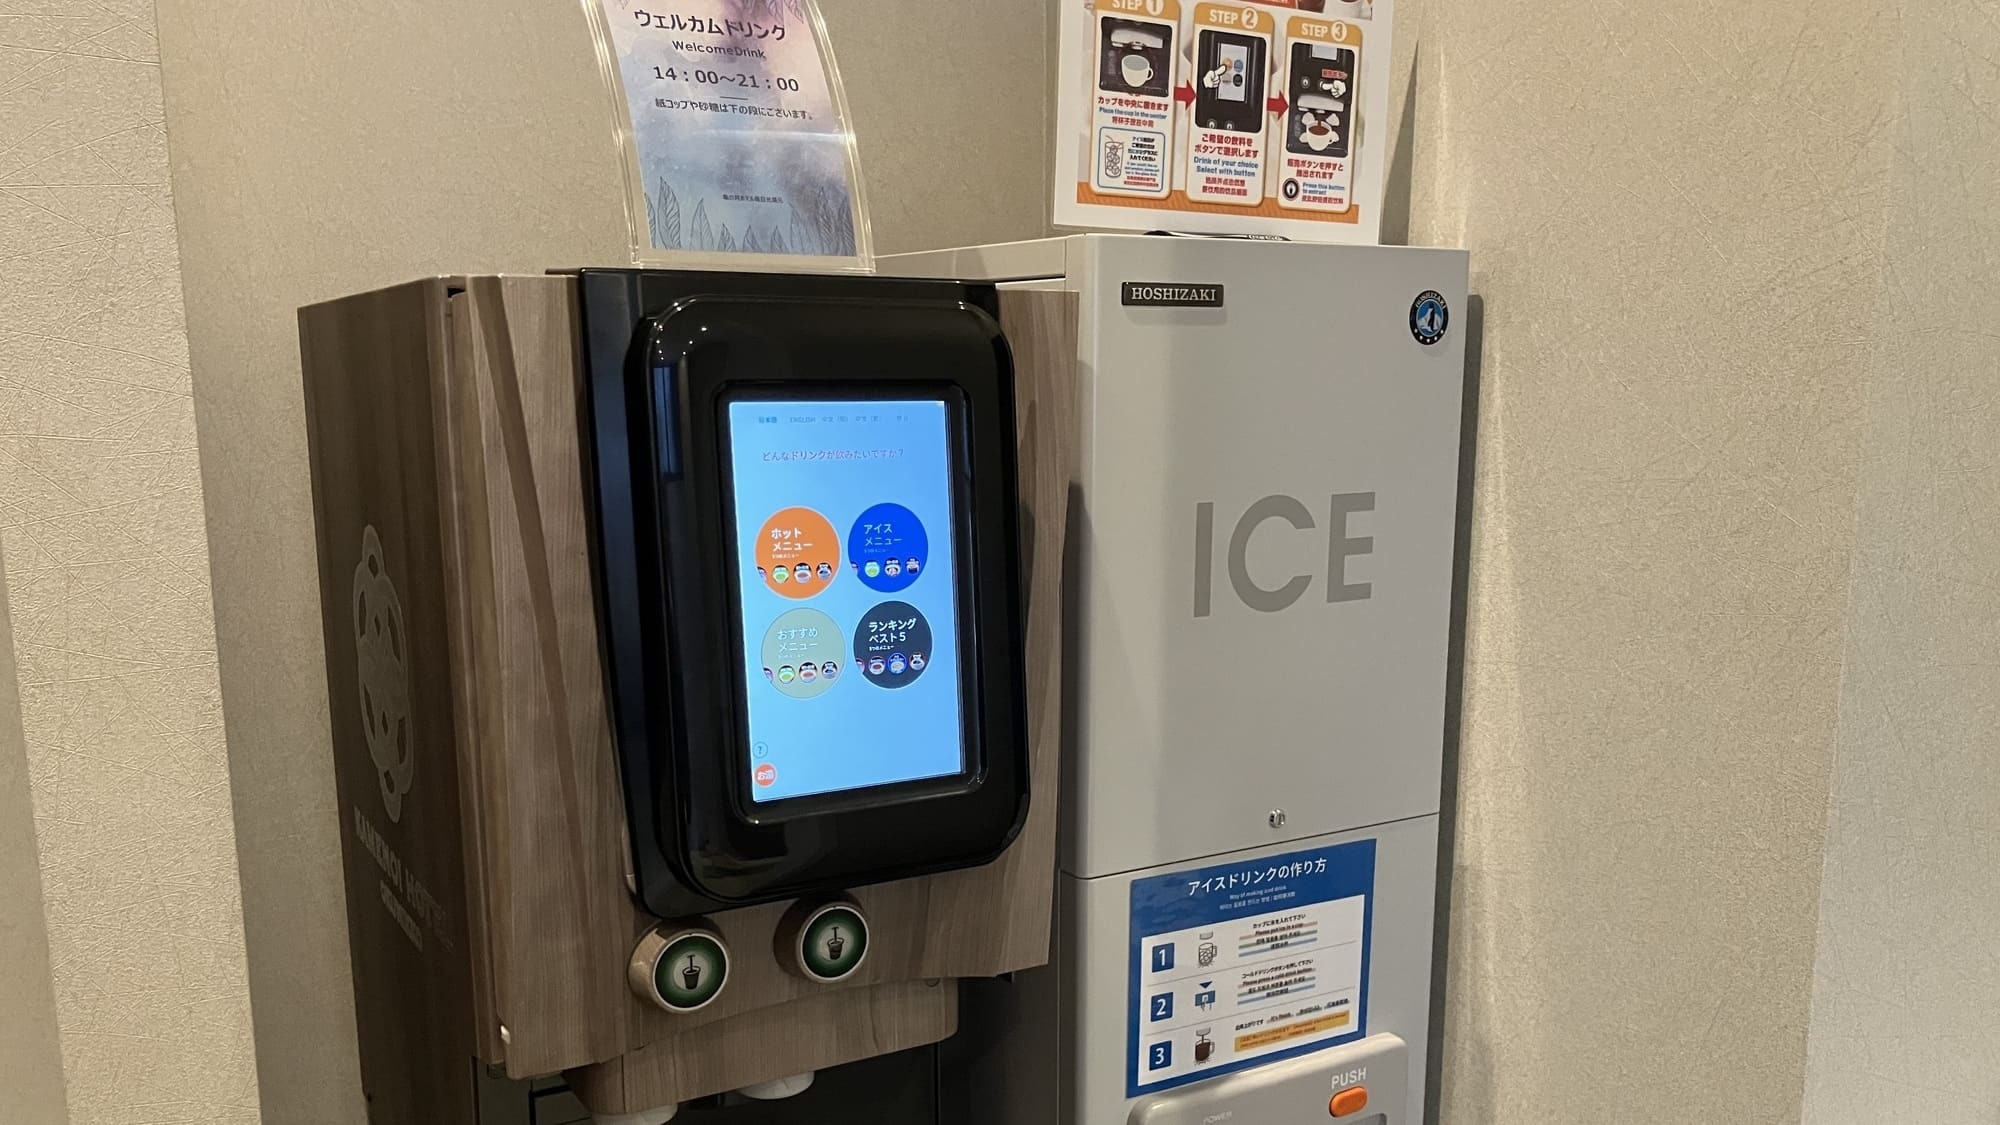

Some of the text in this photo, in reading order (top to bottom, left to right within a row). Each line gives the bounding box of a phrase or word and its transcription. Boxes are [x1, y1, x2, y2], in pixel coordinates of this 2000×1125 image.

[1209, 9, 1239, 24] STEP
[634, 9, 786, 41] ウェルカムドリンク
[1301, 22, 1329, 38] STEP
[672, 40, 766, 59] WelcomeDrink
[1202, 133, 1253, 147] ご希望の飲料を
[1195, 144, 1259, 158] ボタンで選択します
[1194, 156, 1212, 165] Drink
[1238, 160, 1259, 169] choice
[1196, 165, 1218, 173] Select
[1234, 169, 1256, 177] button
[1131, 286, 1217, 303] HOSHIZAKI
[771, 527, 802, 540] ホット
[863, 523, 893, 535] アイス
[772, 541, 814, 552] メニュー
[865, 537, 903, 547] メニュー
[1193, 491, 1376, 618] ICE
[868, 617, 917, 633] ランキング
[777, 627, 818, 640] おすすめ
[779, 642, 819, 653] メニュー
[1188, 857, 1328, 897] アイスドリンクの作り方
[1159, 948, 1166, 966] 1
[1157, 998, 1166, 1016] 2
[1155, 1047, 1164, 1065] 3
[1331, 1067, 1367, 1090] PUSH
